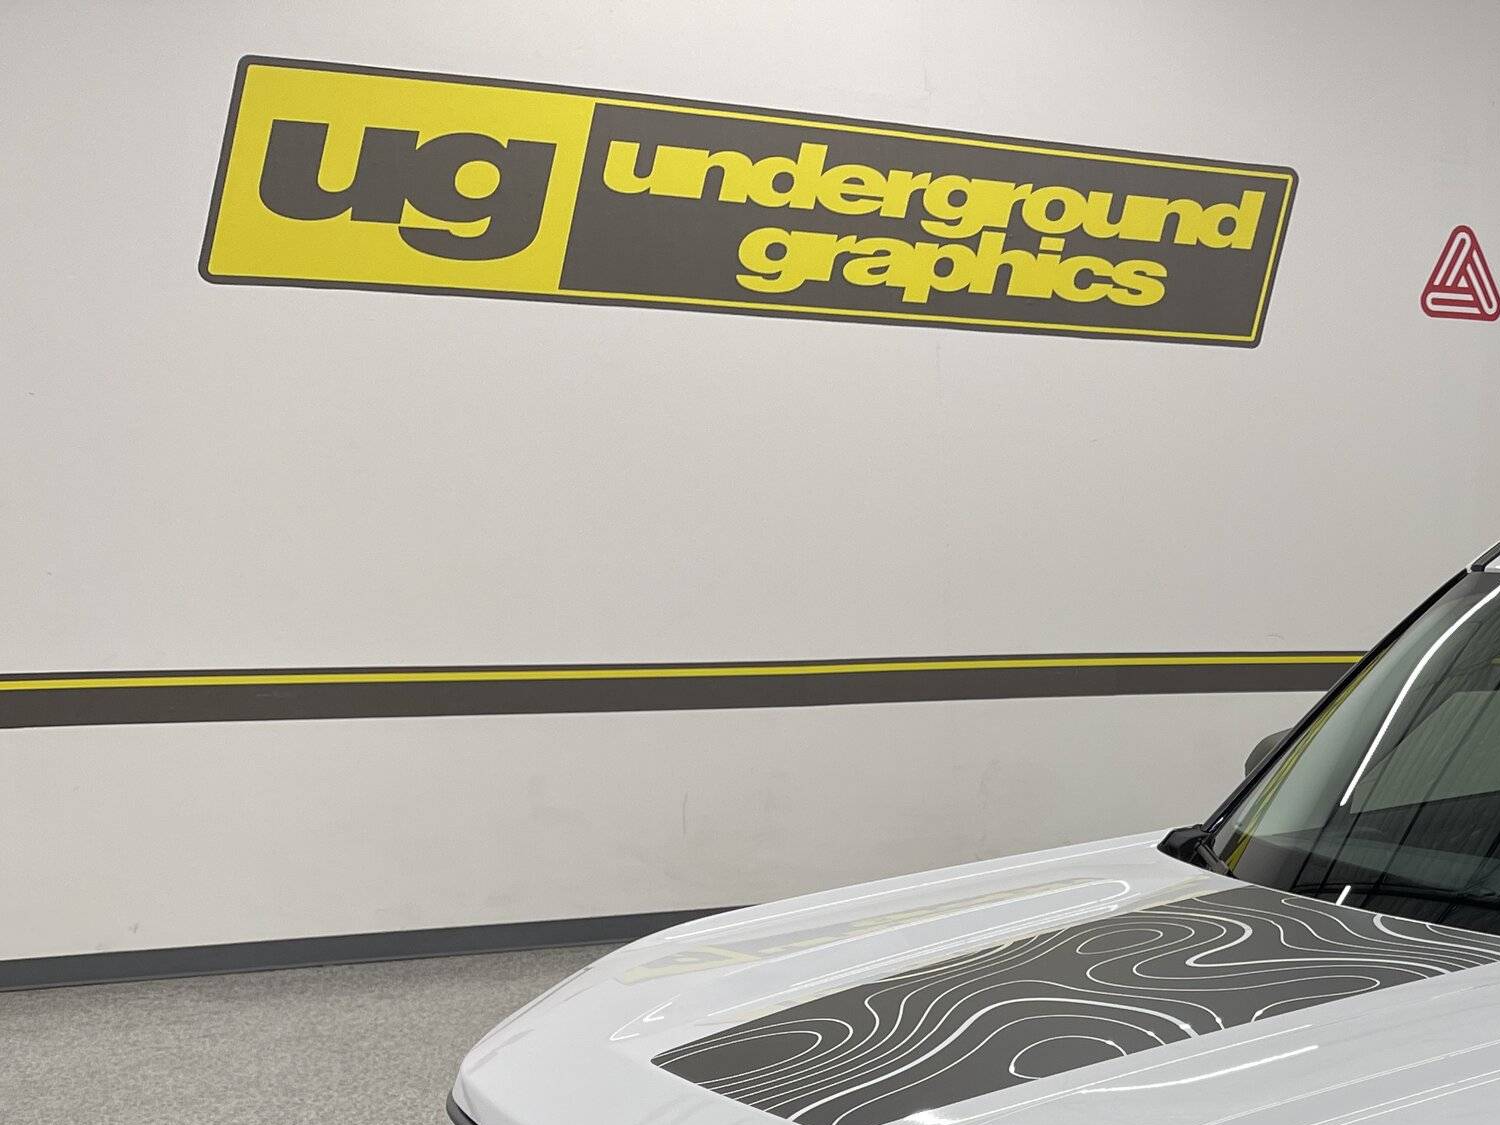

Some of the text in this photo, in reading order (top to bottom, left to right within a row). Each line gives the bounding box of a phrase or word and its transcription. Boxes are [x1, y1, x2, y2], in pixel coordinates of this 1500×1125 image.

[258, 118, 558, 262] ug
[602, 138, 1267, 251] underground
[736, 222, 1168, 308] graphics
